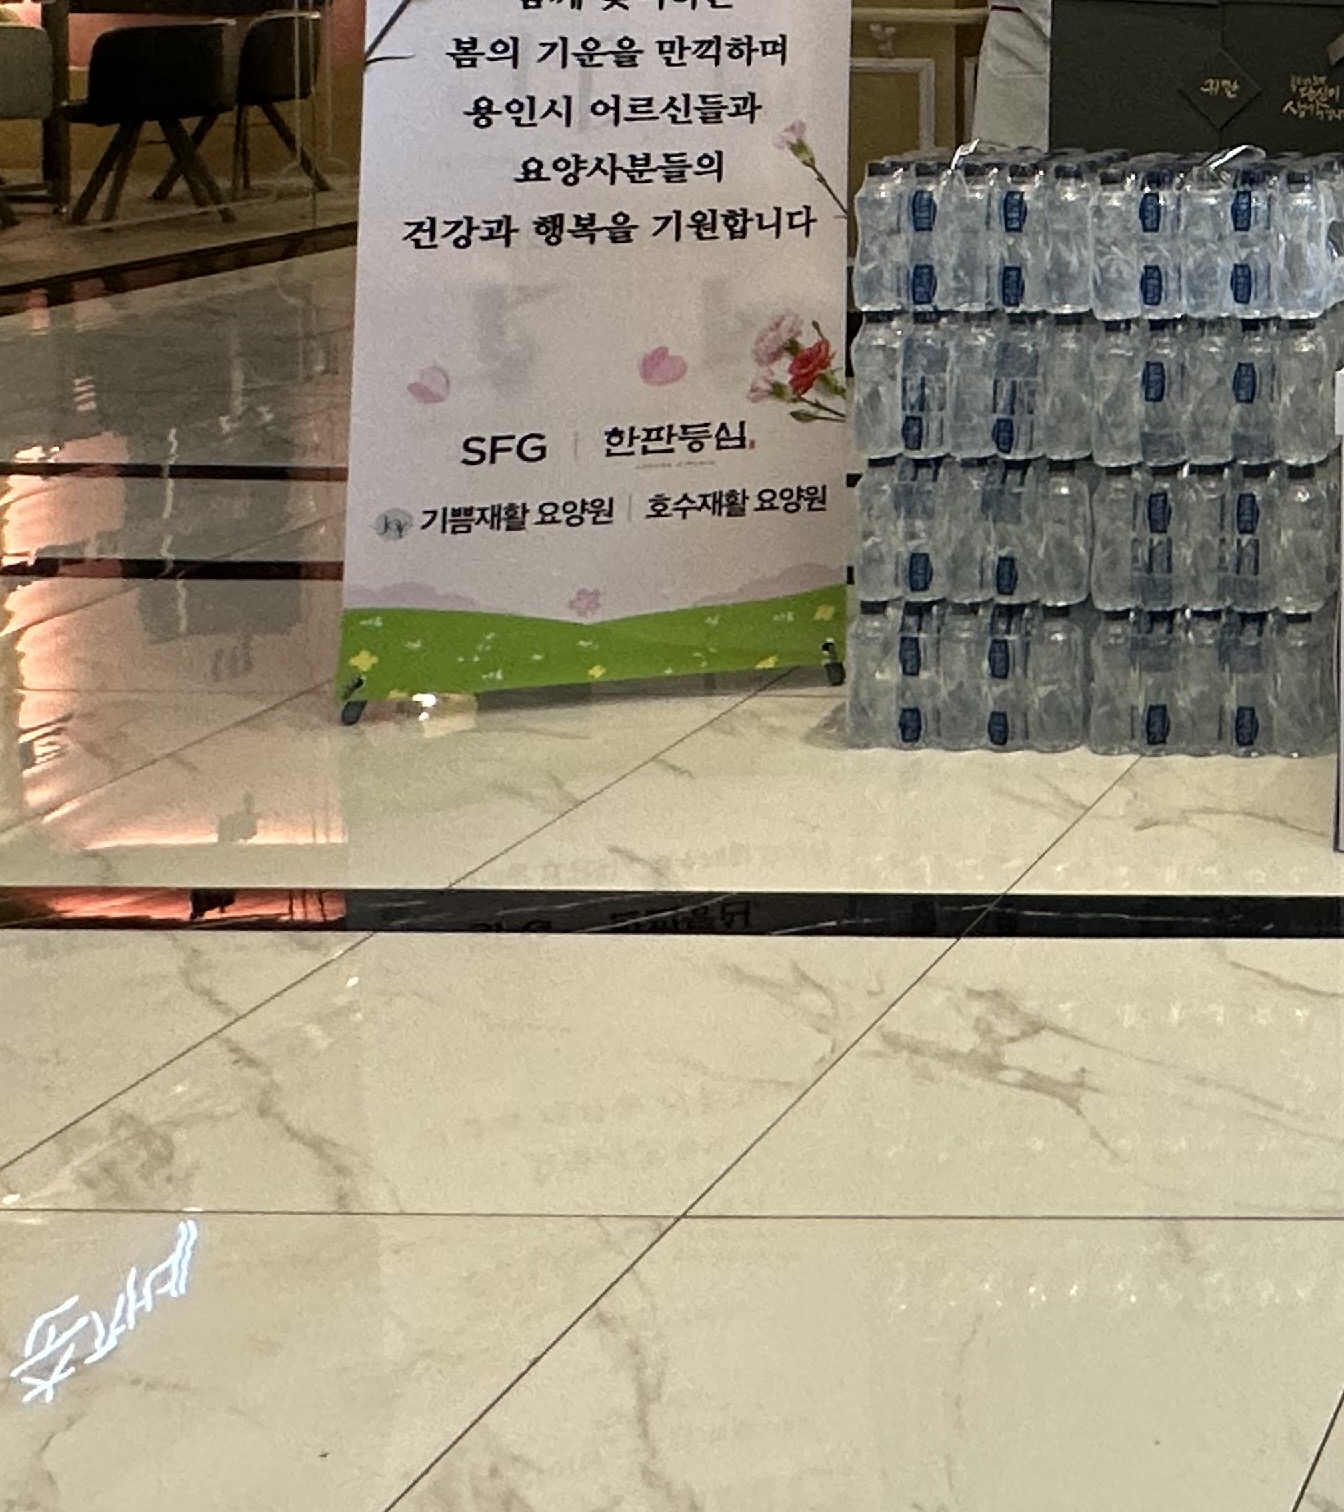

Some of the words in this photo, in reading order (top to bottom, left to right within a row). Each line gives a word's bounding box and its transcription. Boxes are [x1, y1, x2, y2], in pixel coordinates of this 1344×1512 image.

[445, 35, 520, 70] 봄의
[536, 35, 644, 69] 기운을
[656, 33, 788, 68] 만끽하며
[462, 94, 573, 129] 용인시
[589, 91, 762, 128] 어르신들과
[514, 149, 725, 187] 요양사분들의
[402, 212, 519, 250] 건강과
[532, 210, 640, 246] 행복을
[651, 204, 818, 243] 기원합니다
[461, 432, 548, 466] SFG
[419, 501, 530, 536] 기쁨재활
[533, 497, 615, 528] 요양원
[645, 487, 749, 521] 호수재활
[753, 483, 828, 515] 요양원
